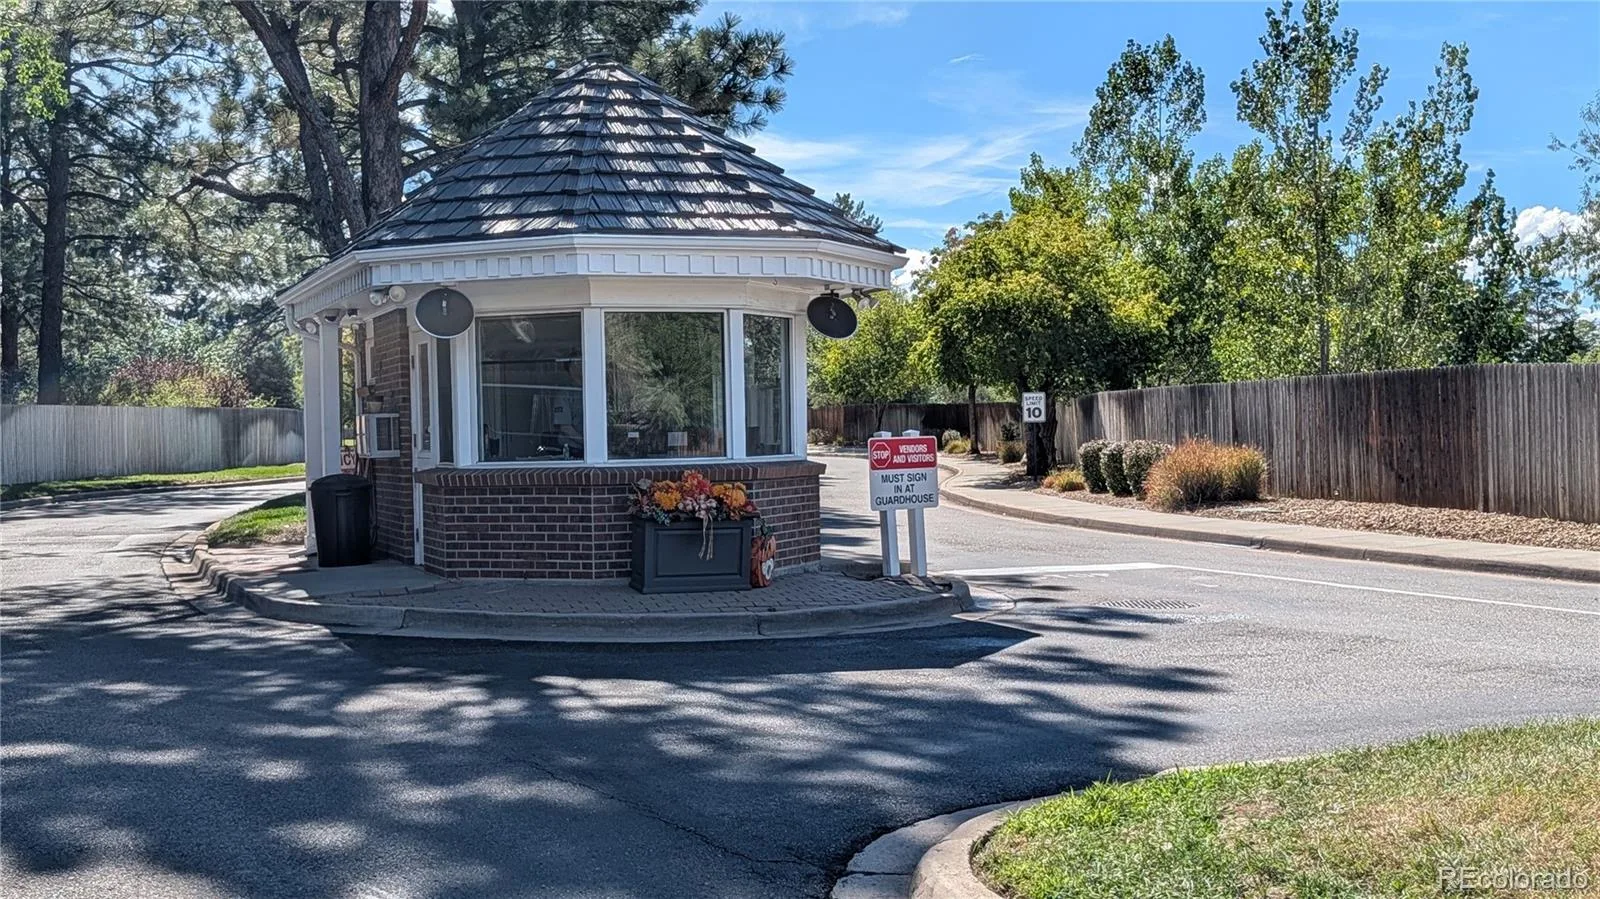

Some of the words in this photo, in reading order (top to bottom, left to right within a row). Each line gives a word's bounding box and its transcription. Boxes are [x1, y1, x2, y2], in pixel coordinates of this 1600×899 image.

[1025, 407, 1042, 418] 10
[899, 444, 928, 453] VENDORS
[873, 450, 889, 459] STOP
[893, 455, 906, 464] AND
[907, 453, 934, 463] VISITORS
[881, 473, 904, 483] MUST
[906, 472, 927, 482] SIGN
[894, 484, 903, 493] IN
[905, 484, 915, 493] AT
[875, 493, 934, 505] GUARDHOUSE
